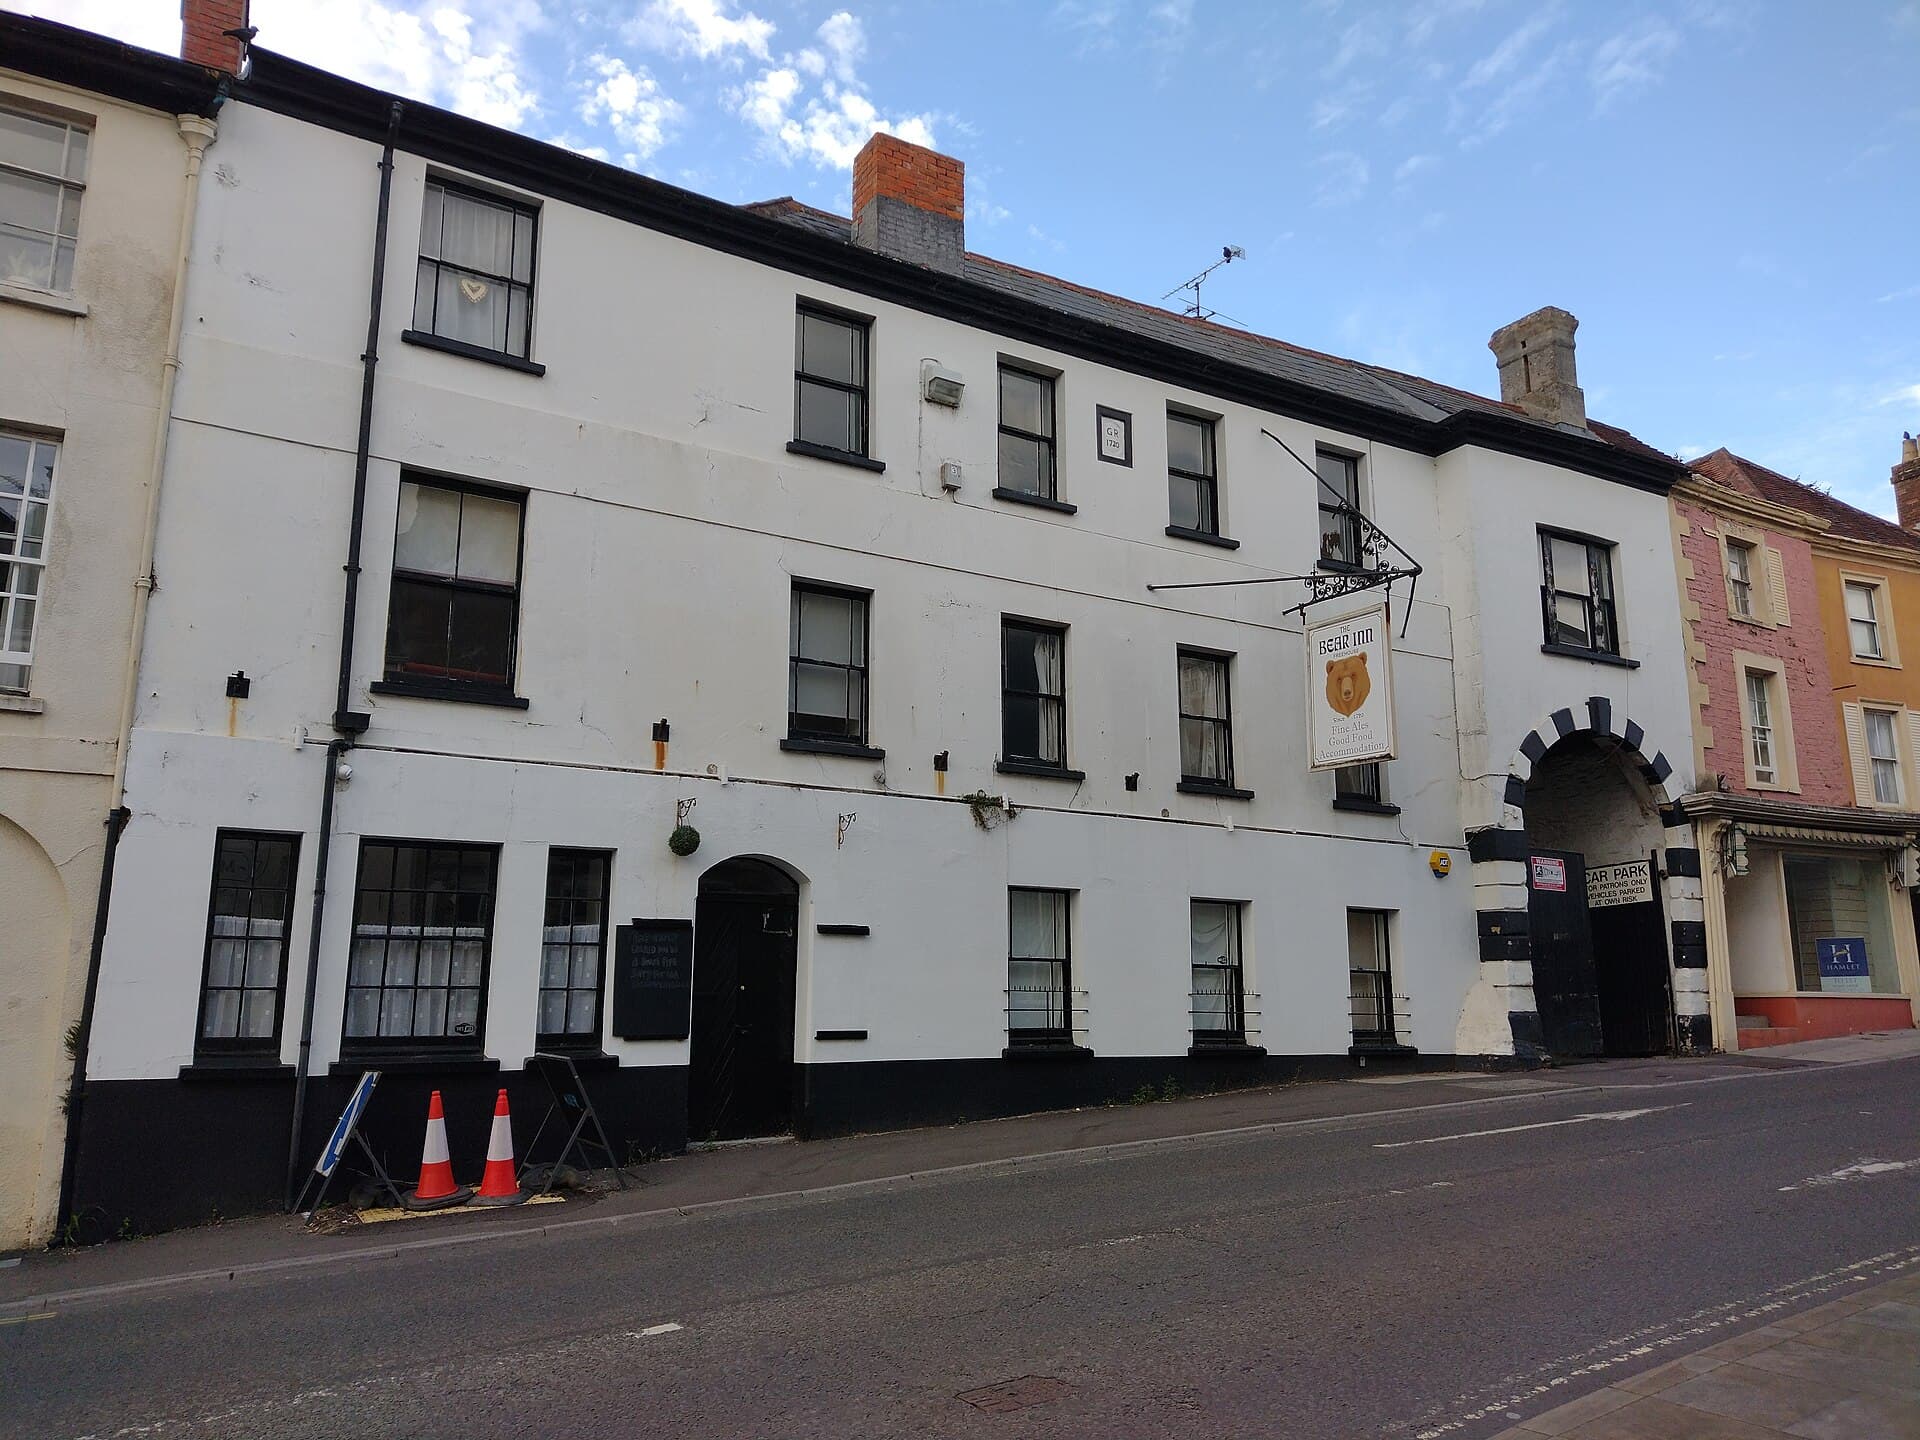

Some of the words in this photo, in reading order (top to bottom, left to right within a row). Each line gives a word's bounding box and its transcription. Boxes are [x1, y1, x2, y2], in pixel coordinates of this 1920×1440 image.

[1340, 624, 1350, 633] THE
[1319, 634, 1350, 655] BEAR
[1353, 628, 1373, 647] INN
[1332, 725, 1350, 735] Fine
[1352, 721, 1369, 731] Ales
[1329, 734, 1350, 746] Good
[1352, 730, 1373, 743] Food
[1320, 742, 1384, 759] Accommodation
[1613, 865, 1647, 880] PARK
[1587, 884, 1597, 892] OR
[1600, 880, 1628, 890] PATRONS
[1631, 877, 1647, 886] ONLY
[1619, 886, 1645, 896] PARKED
[1604, 897, 1620, 905] OWN
[1622, 895, 1638, 903] RISK
[1826, 963, 1860, 971] HAMLET
